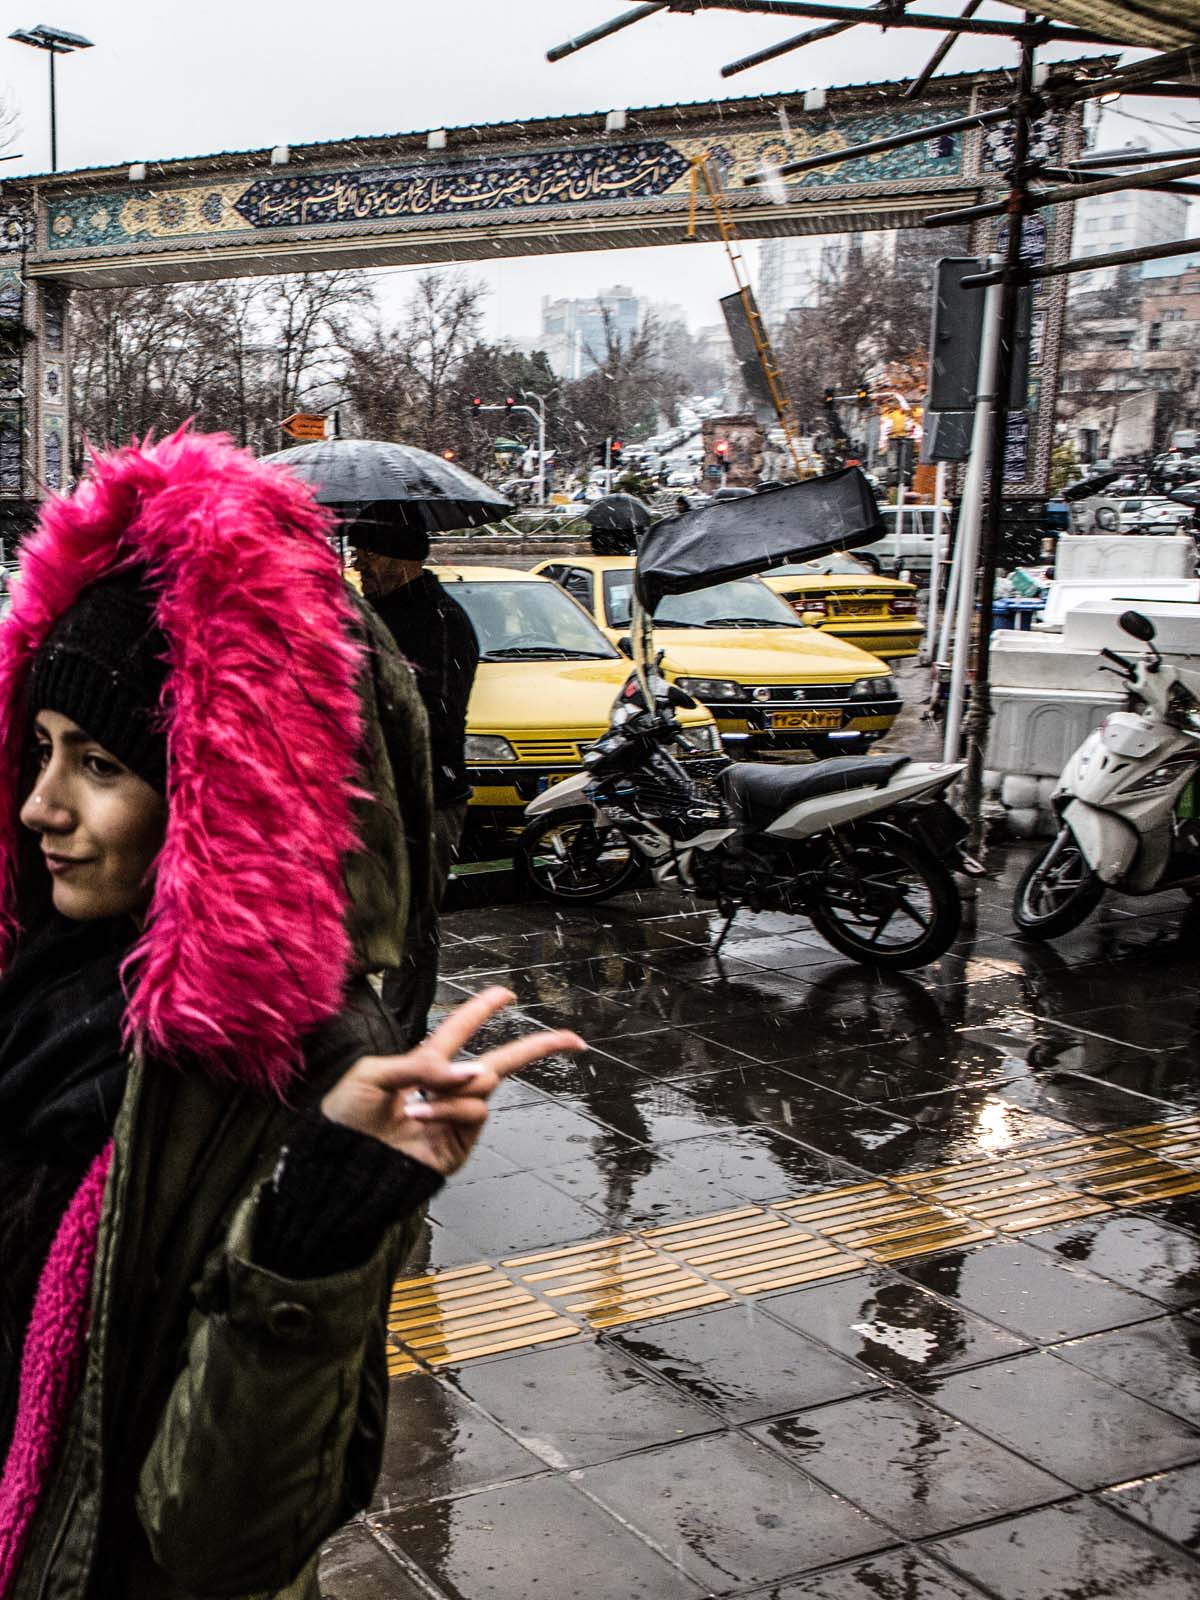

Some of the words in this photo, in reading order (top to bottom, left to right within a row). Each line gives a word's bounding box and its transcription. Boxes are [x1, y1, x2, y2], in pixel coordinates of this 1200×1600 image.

[411, 177, 452, 213] صالح
[449, 174, 531, 208] حضرت
[523, 167, 572, 203] مقدس
[569, 156, 661, 200] آستان
